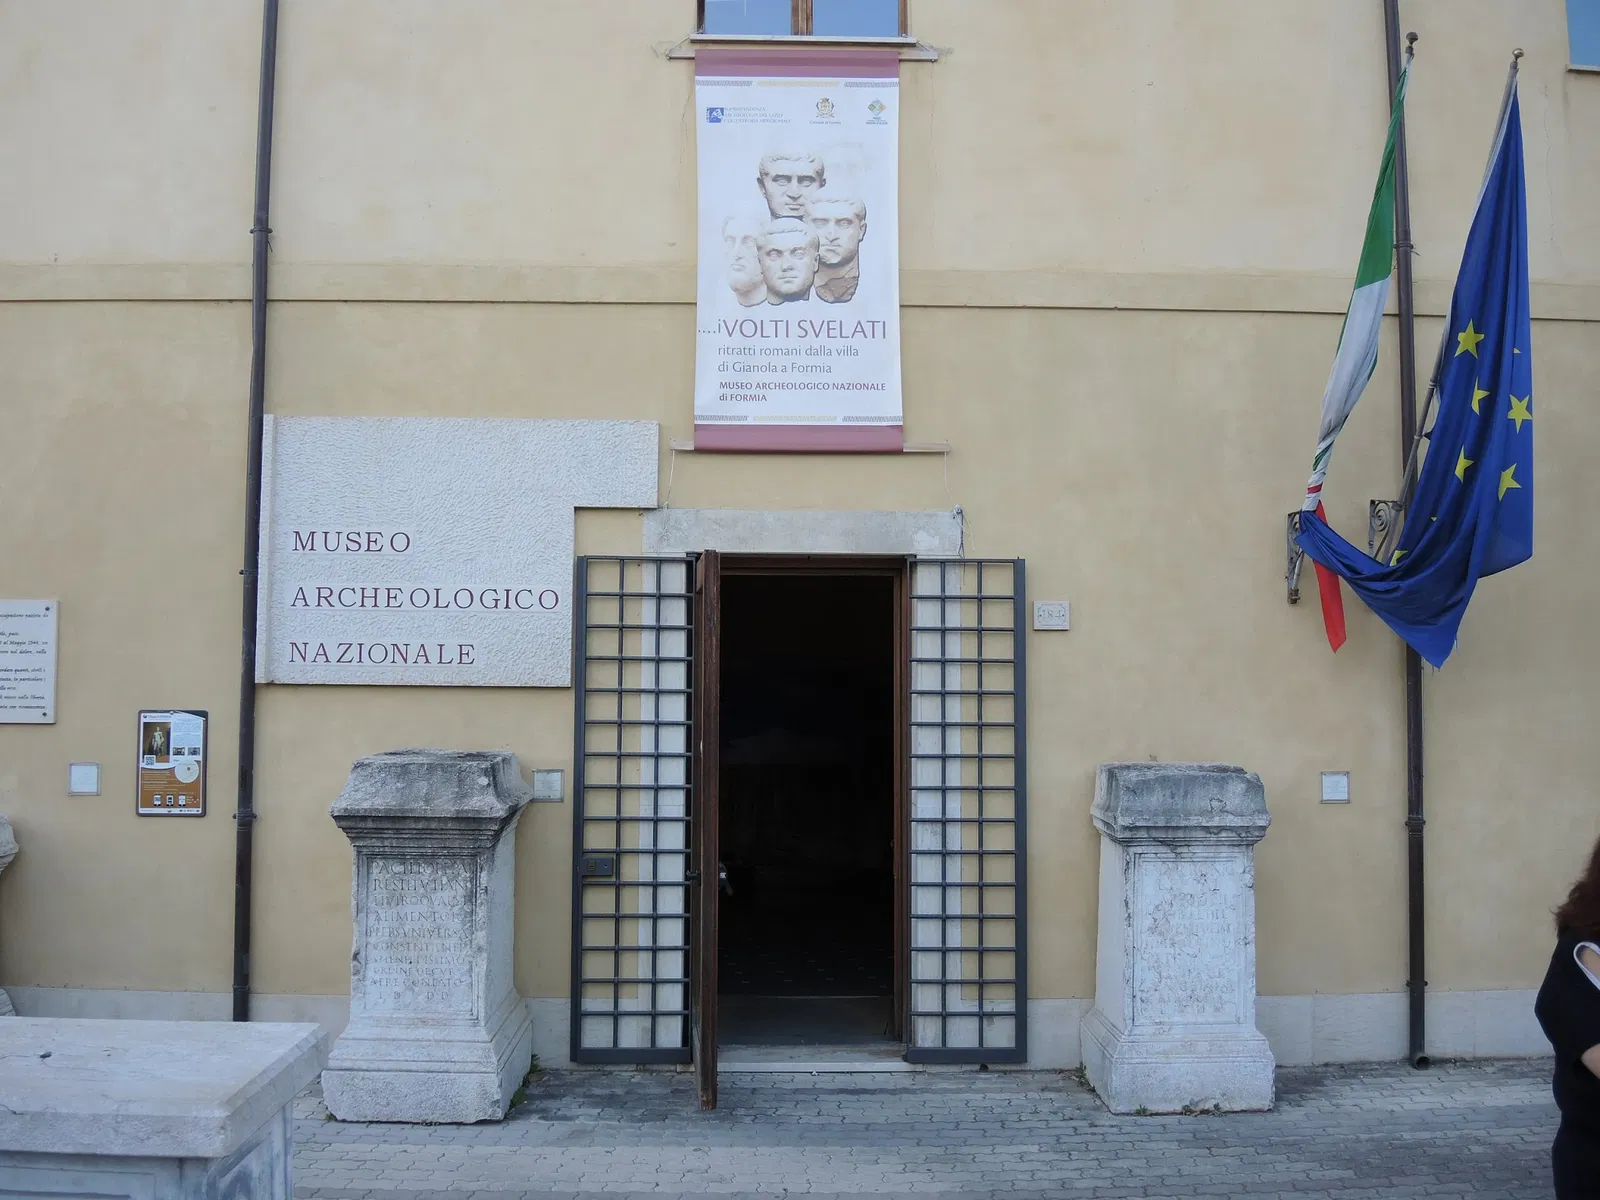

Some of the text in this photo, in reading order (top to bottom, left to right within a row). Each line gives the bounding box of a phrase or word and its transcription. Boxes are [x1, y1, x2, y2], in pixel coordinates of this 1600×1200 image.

[797, 319, 887, 339] SVELATI
[717, 344, 859, 357] ritratti romani dalla villa
[717, 361, 729, 373] di
[732, 361, 778, 373] Gianola
[791, 362, 832, 374] Formia
[719, 382, 886, 391] MUSEO ARCHEOLOGICO NAZIONALE
[719, 393, 768, 402] di FORMIA
[291, 530, 411, 553] MUSEO
[290, 586, 560, 610] ARCHEOLOGICO
[288, 642, 476, 665] NAZIONALE
